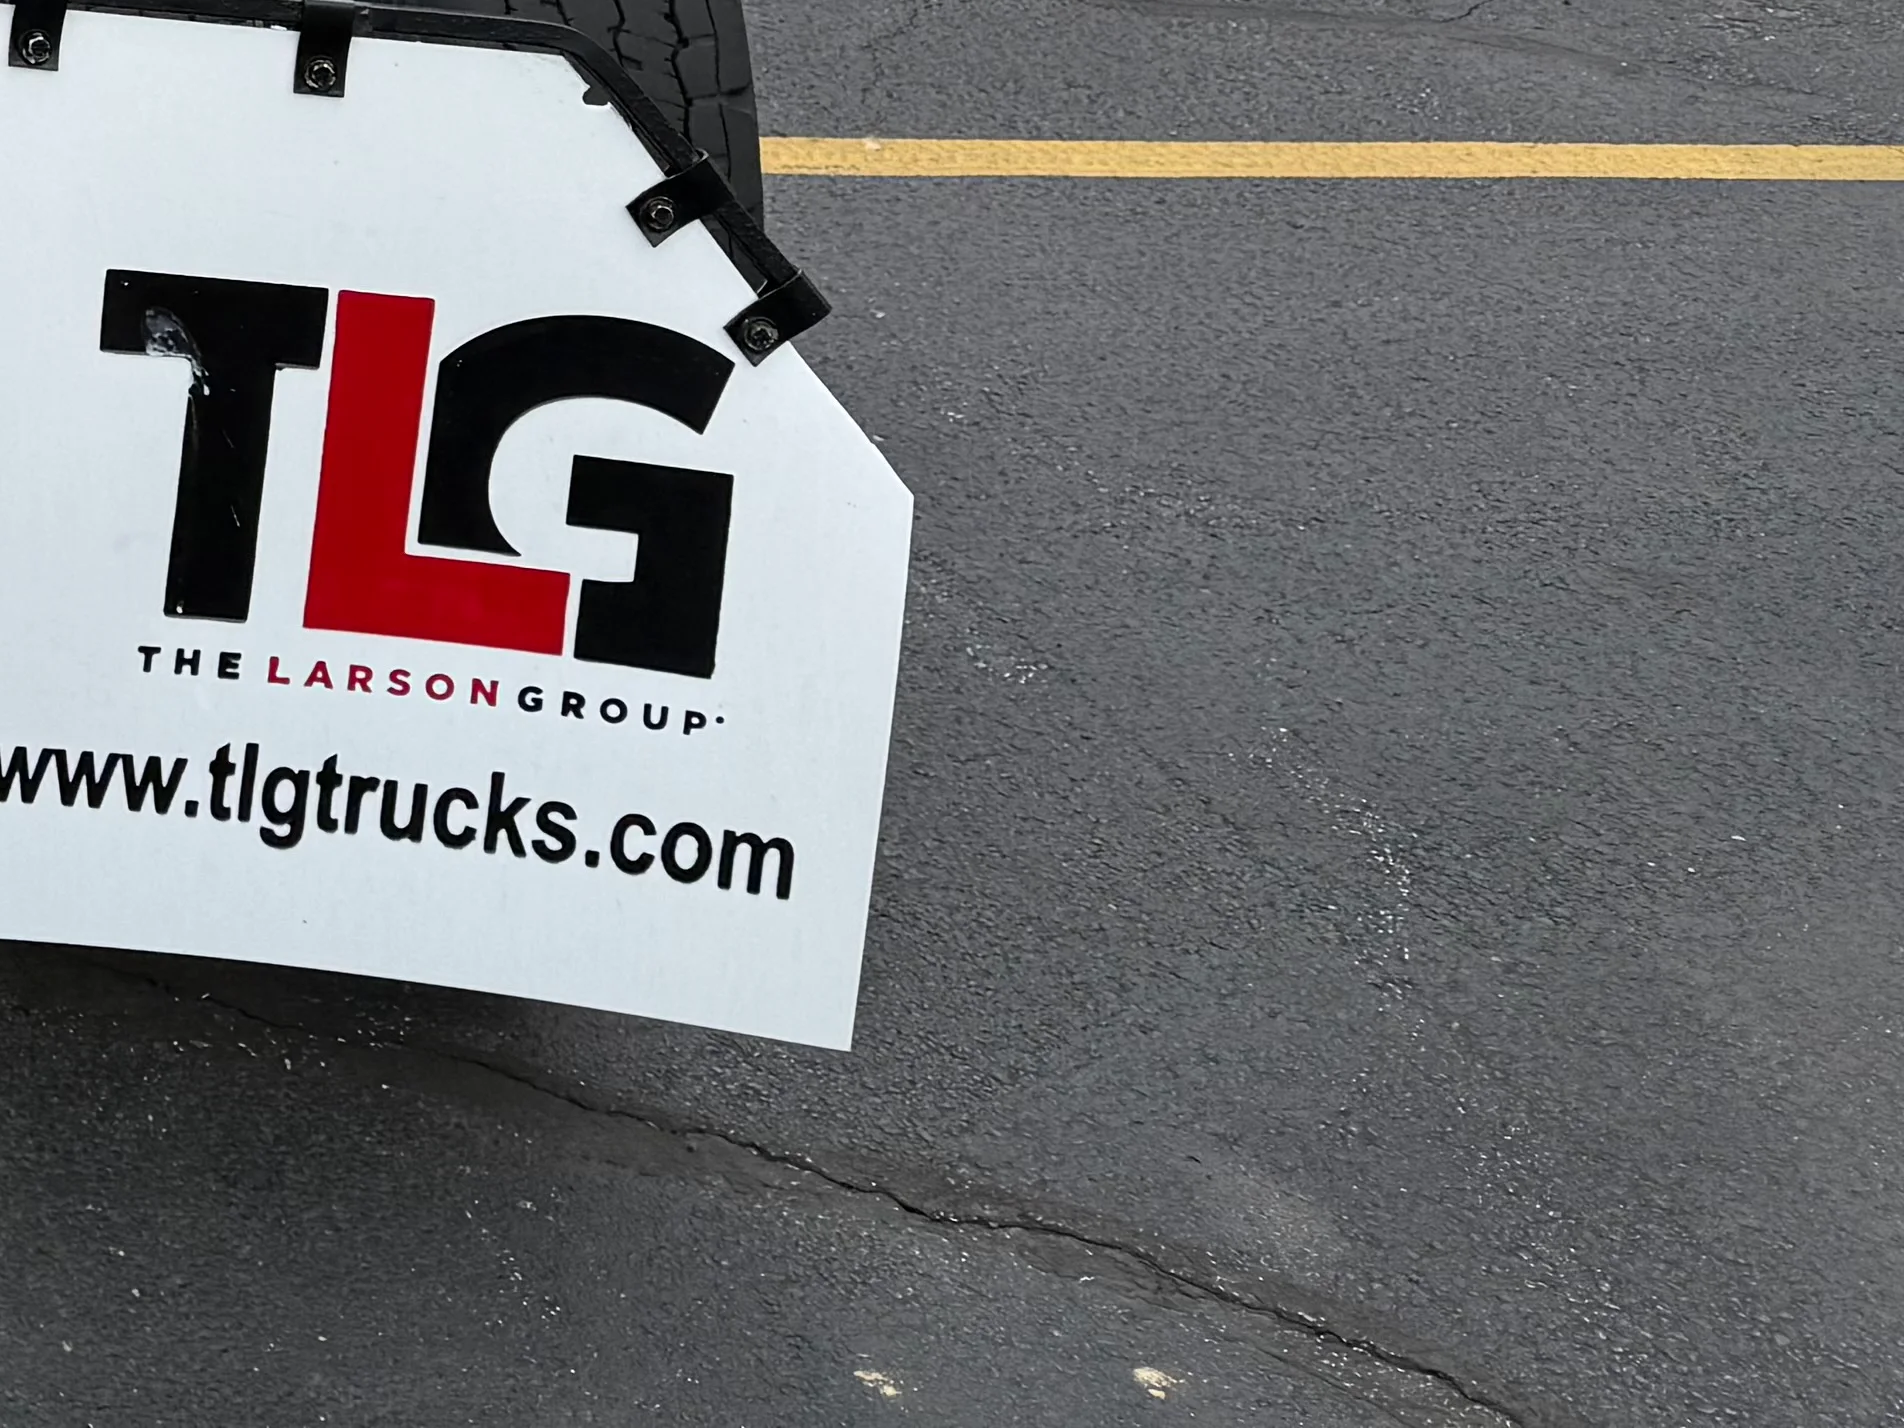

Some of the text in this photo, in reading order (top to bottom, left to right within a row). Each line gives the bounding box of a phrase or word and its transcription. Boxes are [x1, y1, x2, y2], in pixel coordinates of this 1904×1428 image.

[99, 268, 735, 679] TLG
[137, 645, 708, 736] THE LARSON GROUP
